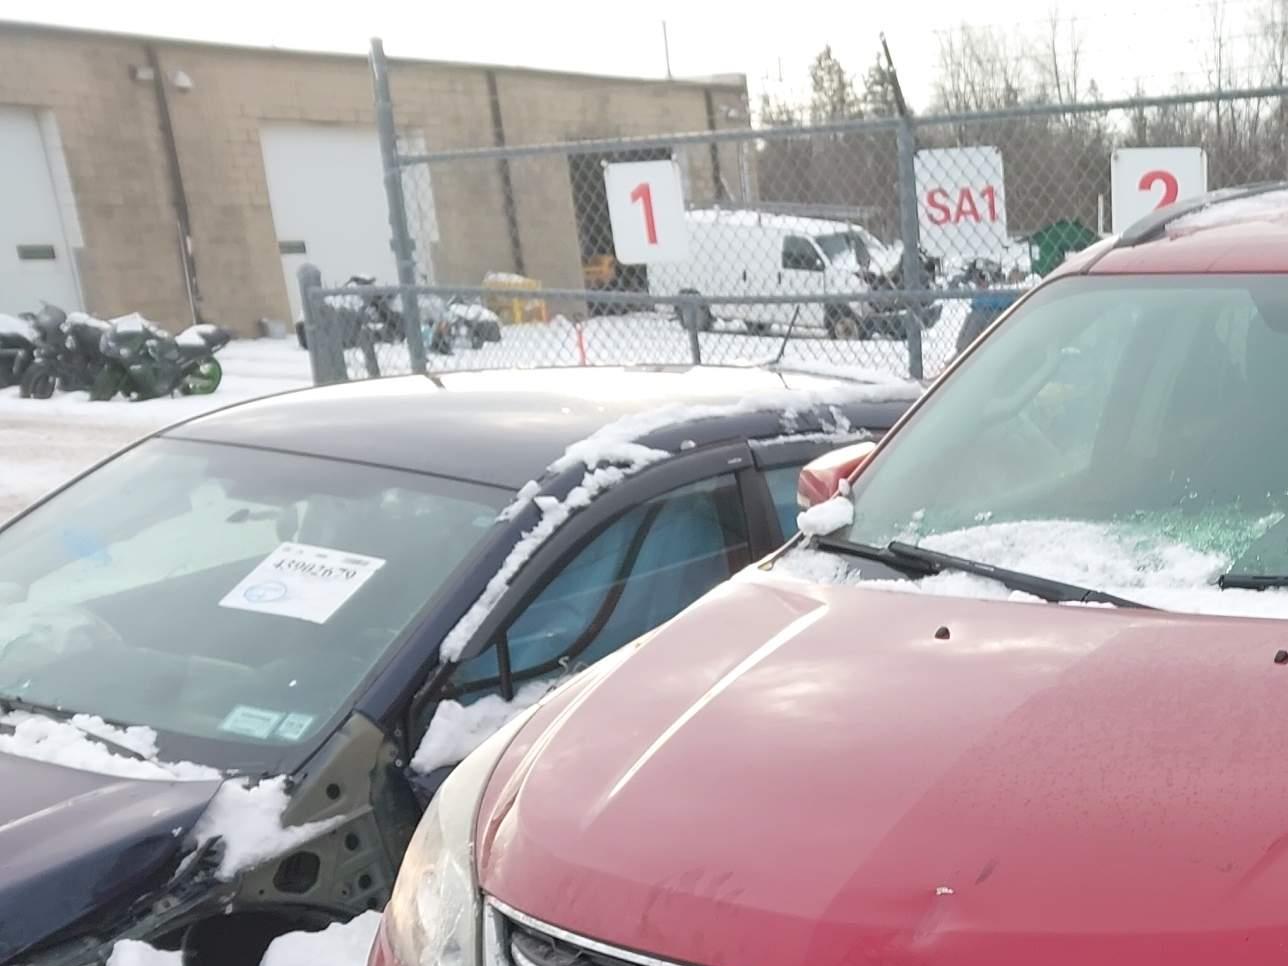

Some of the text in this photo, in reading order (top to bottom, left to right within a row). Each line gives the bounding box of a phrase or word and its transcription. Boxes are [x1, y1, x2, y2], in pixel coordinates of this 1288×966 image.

[925, 185, 998, 226] SA1
[1138, 170, 1179, 210] 2
[630, 182, 659, 245] 1
